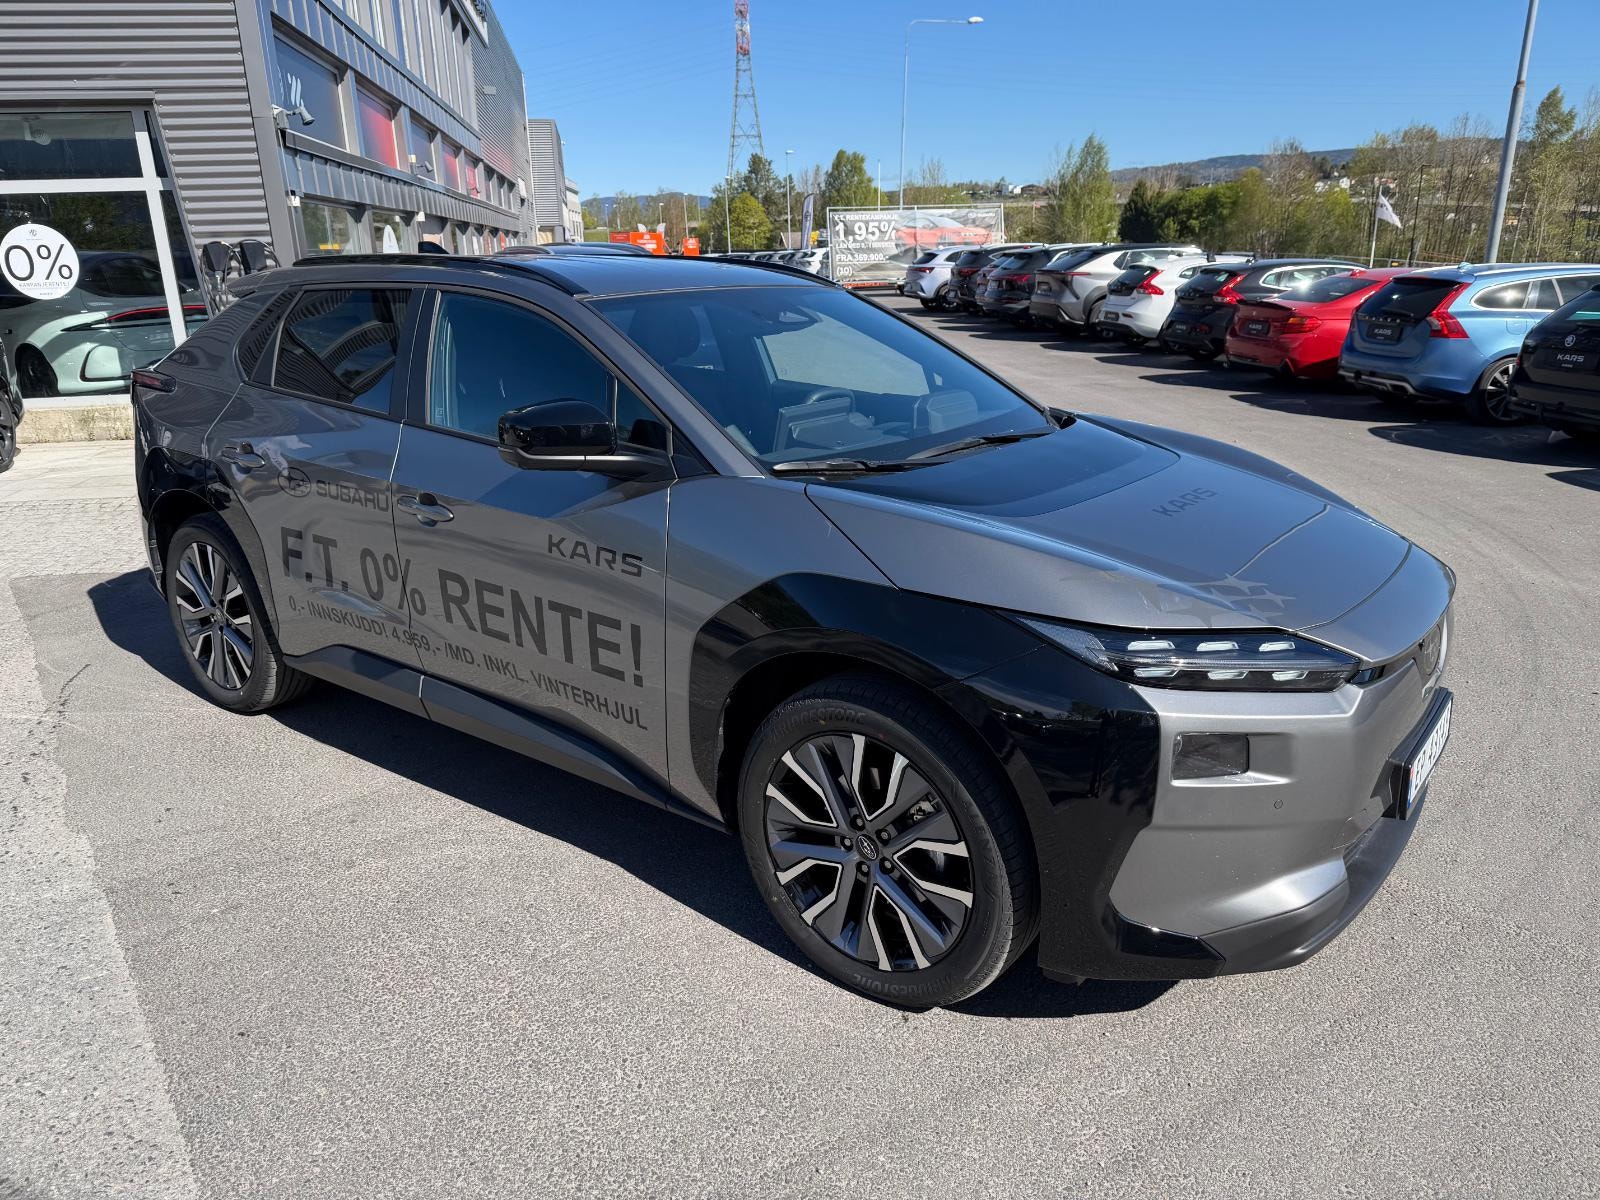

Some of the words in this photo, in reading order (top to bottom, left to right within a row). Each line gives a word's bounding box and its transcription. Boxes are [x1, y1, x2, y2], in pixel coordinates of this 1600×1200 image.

[835, 221, 896, 243] 1,95%
[4, 243, 73, 282] 0%
[836, 254, 853, 262] FRA
[1556, 353, 1585, 362] KARS
[316, 479, 390, 512] SUBARU
[1151, 487, 1219, 517] KARS
[547, 533, 644, 578] KARS
[280, 526, 349, 592] F.T.
[359, 547, 427, 617] 0%
[437, 567, 644, 688] RENTE!
[306, 600, 390, 638] INNSKUDD!
[530, 669, 648, 731] VINTERHJUL
